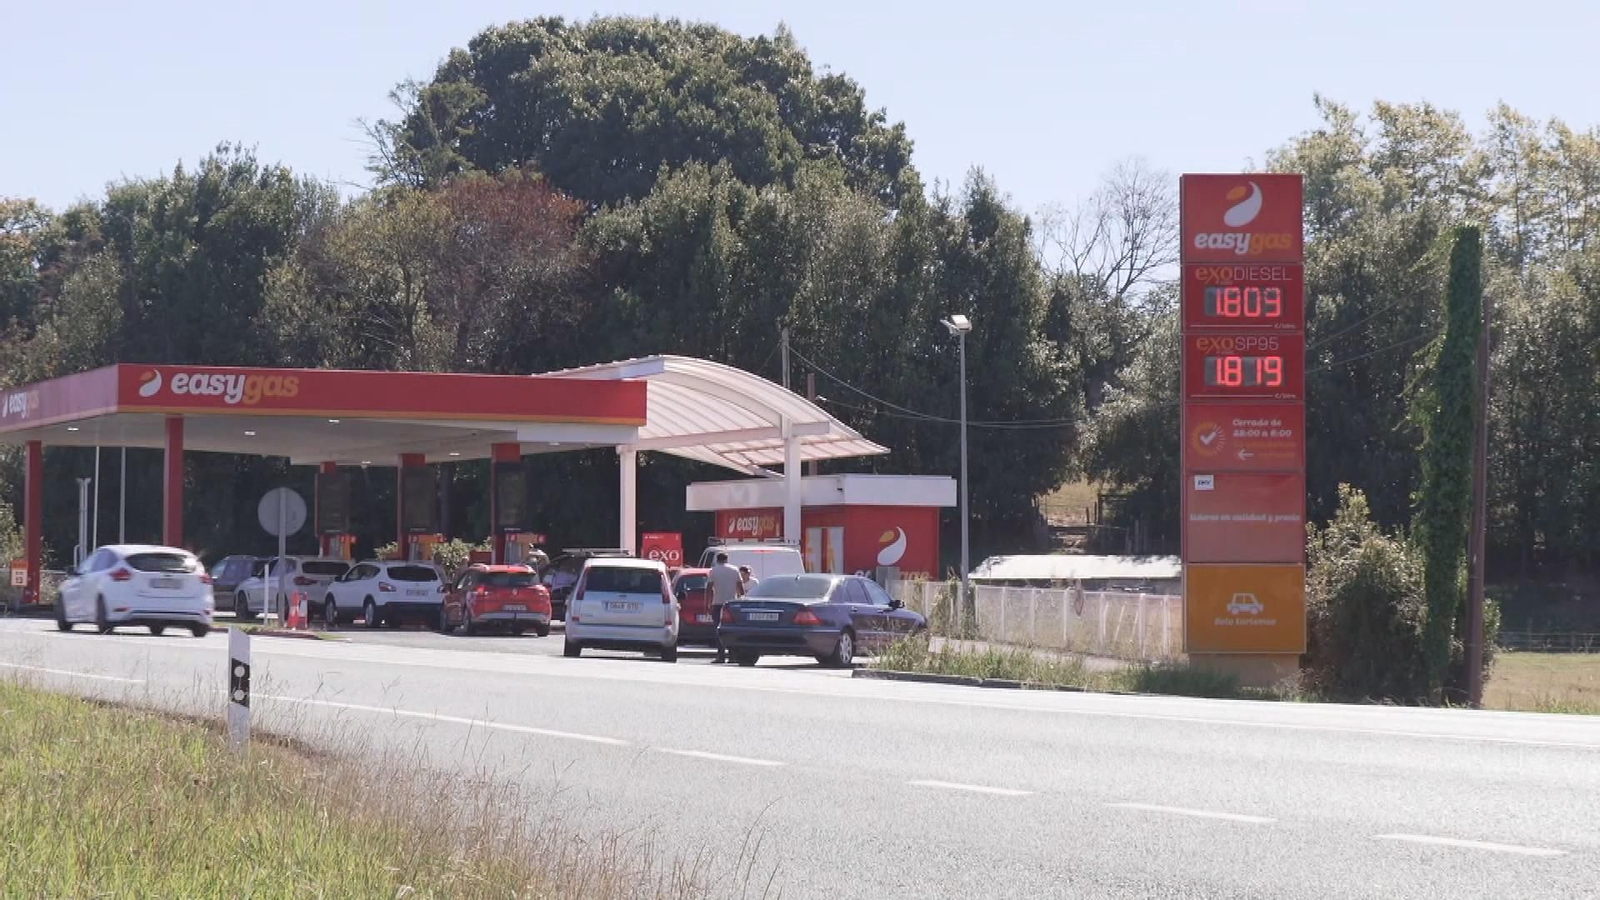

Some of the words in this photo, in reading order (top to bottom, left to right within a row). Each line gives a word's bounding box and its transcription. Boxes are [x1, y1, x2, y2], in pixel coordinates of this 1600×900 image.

[1194, 232, 1293, 255] easygas
[170, 372, 299, 404] easygas
[648, 549, 680, 562] exo
